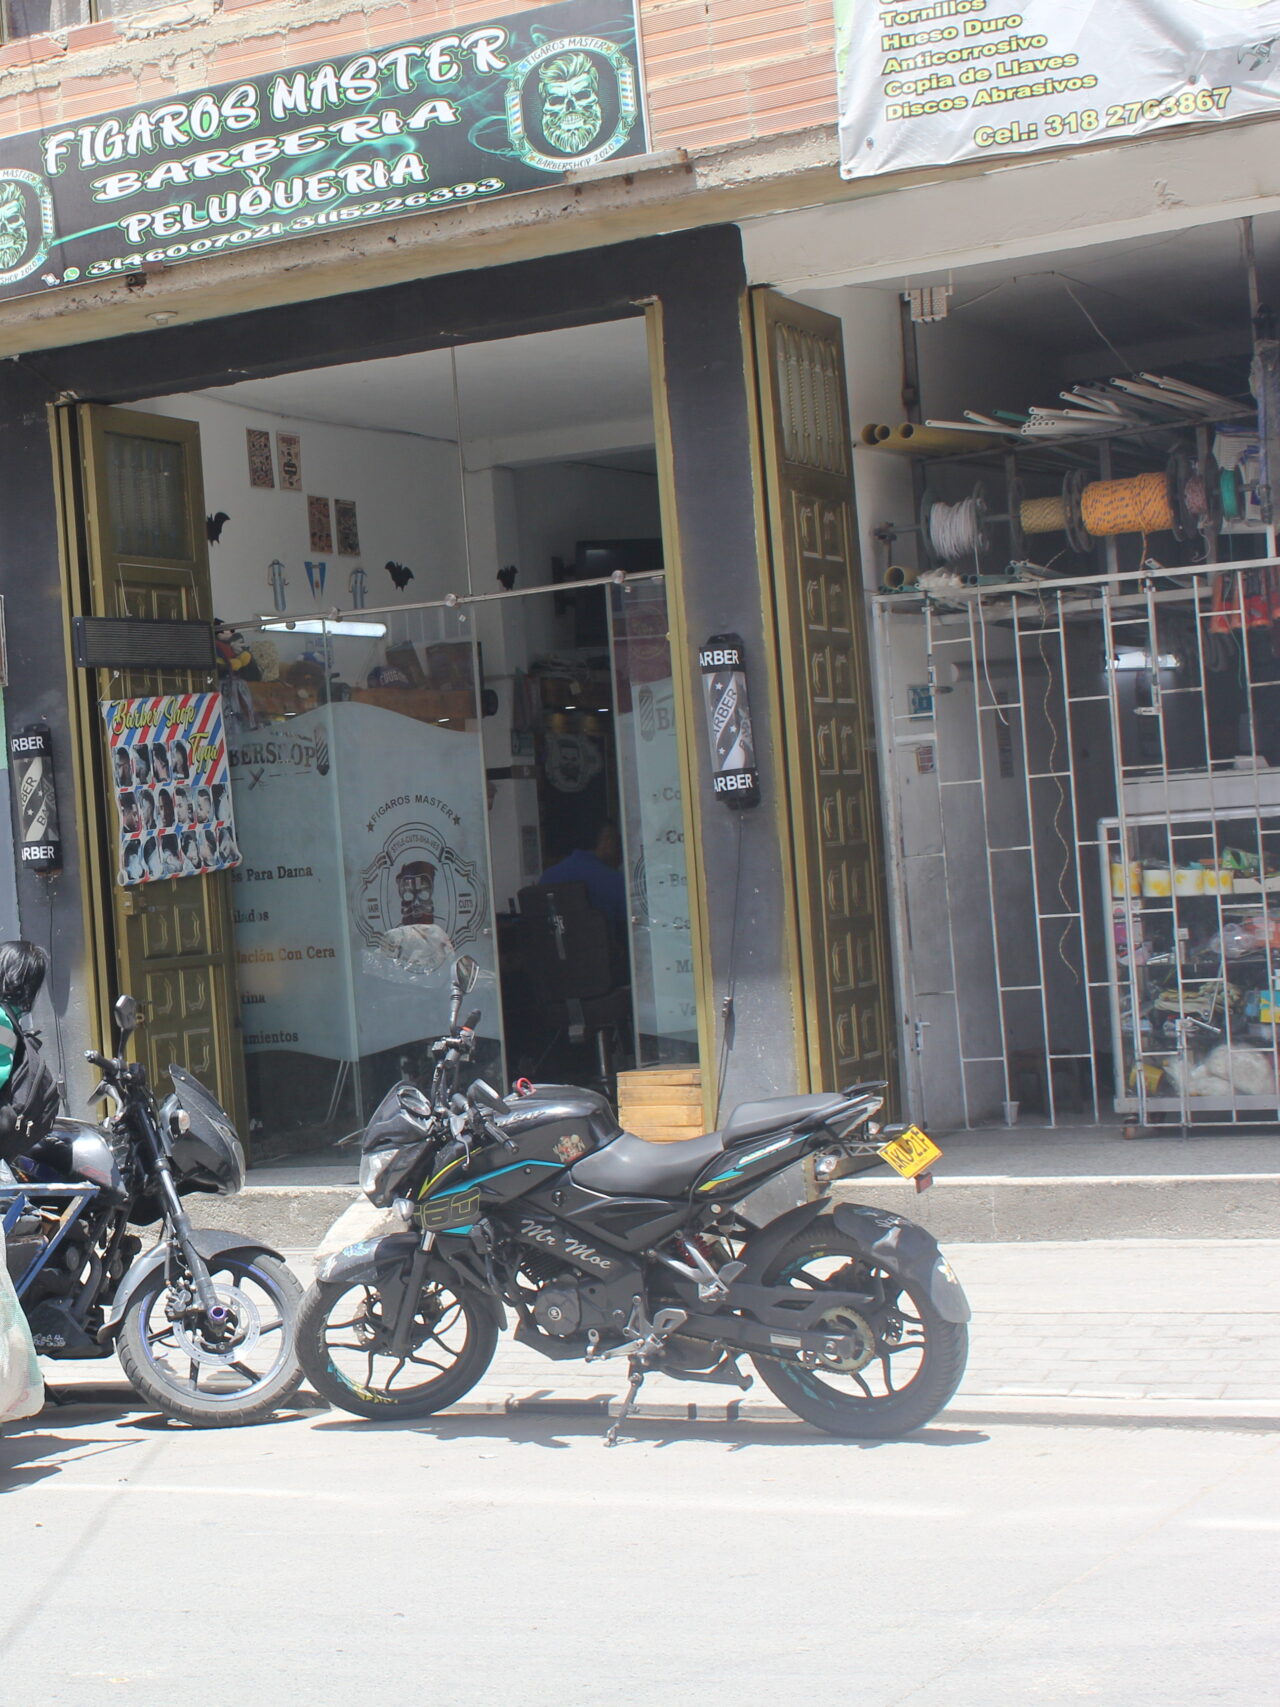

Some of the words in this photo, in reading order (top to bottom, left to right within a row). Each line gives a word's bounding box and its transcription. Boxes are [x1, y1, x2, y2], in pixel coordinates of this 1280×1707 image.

[880, 0, 987, 27] Tornillos
[881, 26, 959, 51] Hueso
[963, 14, 1022, 37] Duro
[568, 38, 608, 51] MASTER
[881, 34, 1048, 75] Anticorrosivo
[884, 73, 955, 97] Copia
[959, 67, 992, 85] de
[996, 53, 1079, 79] Llaves
[43, 83, 258, 175] FIGAROS
[272, 27, 508, 119] MASTER
[886, 96, 968, 121] Discos
[972, 74, 1098, 107] Abrasivos
[974, 121, 1038, 147] Cel.:
[1044, 108, 1099, 137] 318
[1105, 85, 1232, 128] 2763867
[92, 99, 458, 201] BARBERIA
[594, 142, 615, 160] 2020
[245, 166, 268, 186] Y
[120, 153, 426, 243] PELUQUERIA
[88, 223, 283, 276] 3146007021
[291, 178, 504, 231] 3115226393
[110, 700, 160, 735] Barber
[164, 696, 196, 732] Shop
[11, 736, 44, 752] RBER
[370, 795, 411, 824] FIGAROS
[415, 794, 454, 820] MASTER
[22, 845, 55, 861] RBER
[246, 868, 274, 882] Para
[277, 865, 314, 879] Dama
[278, 947, 303, 962] Con
[306, 945, 336, 960] Cera
[521, 1219, 556, 1246] Mr
[565, 1238, 610, 1269] Moe
